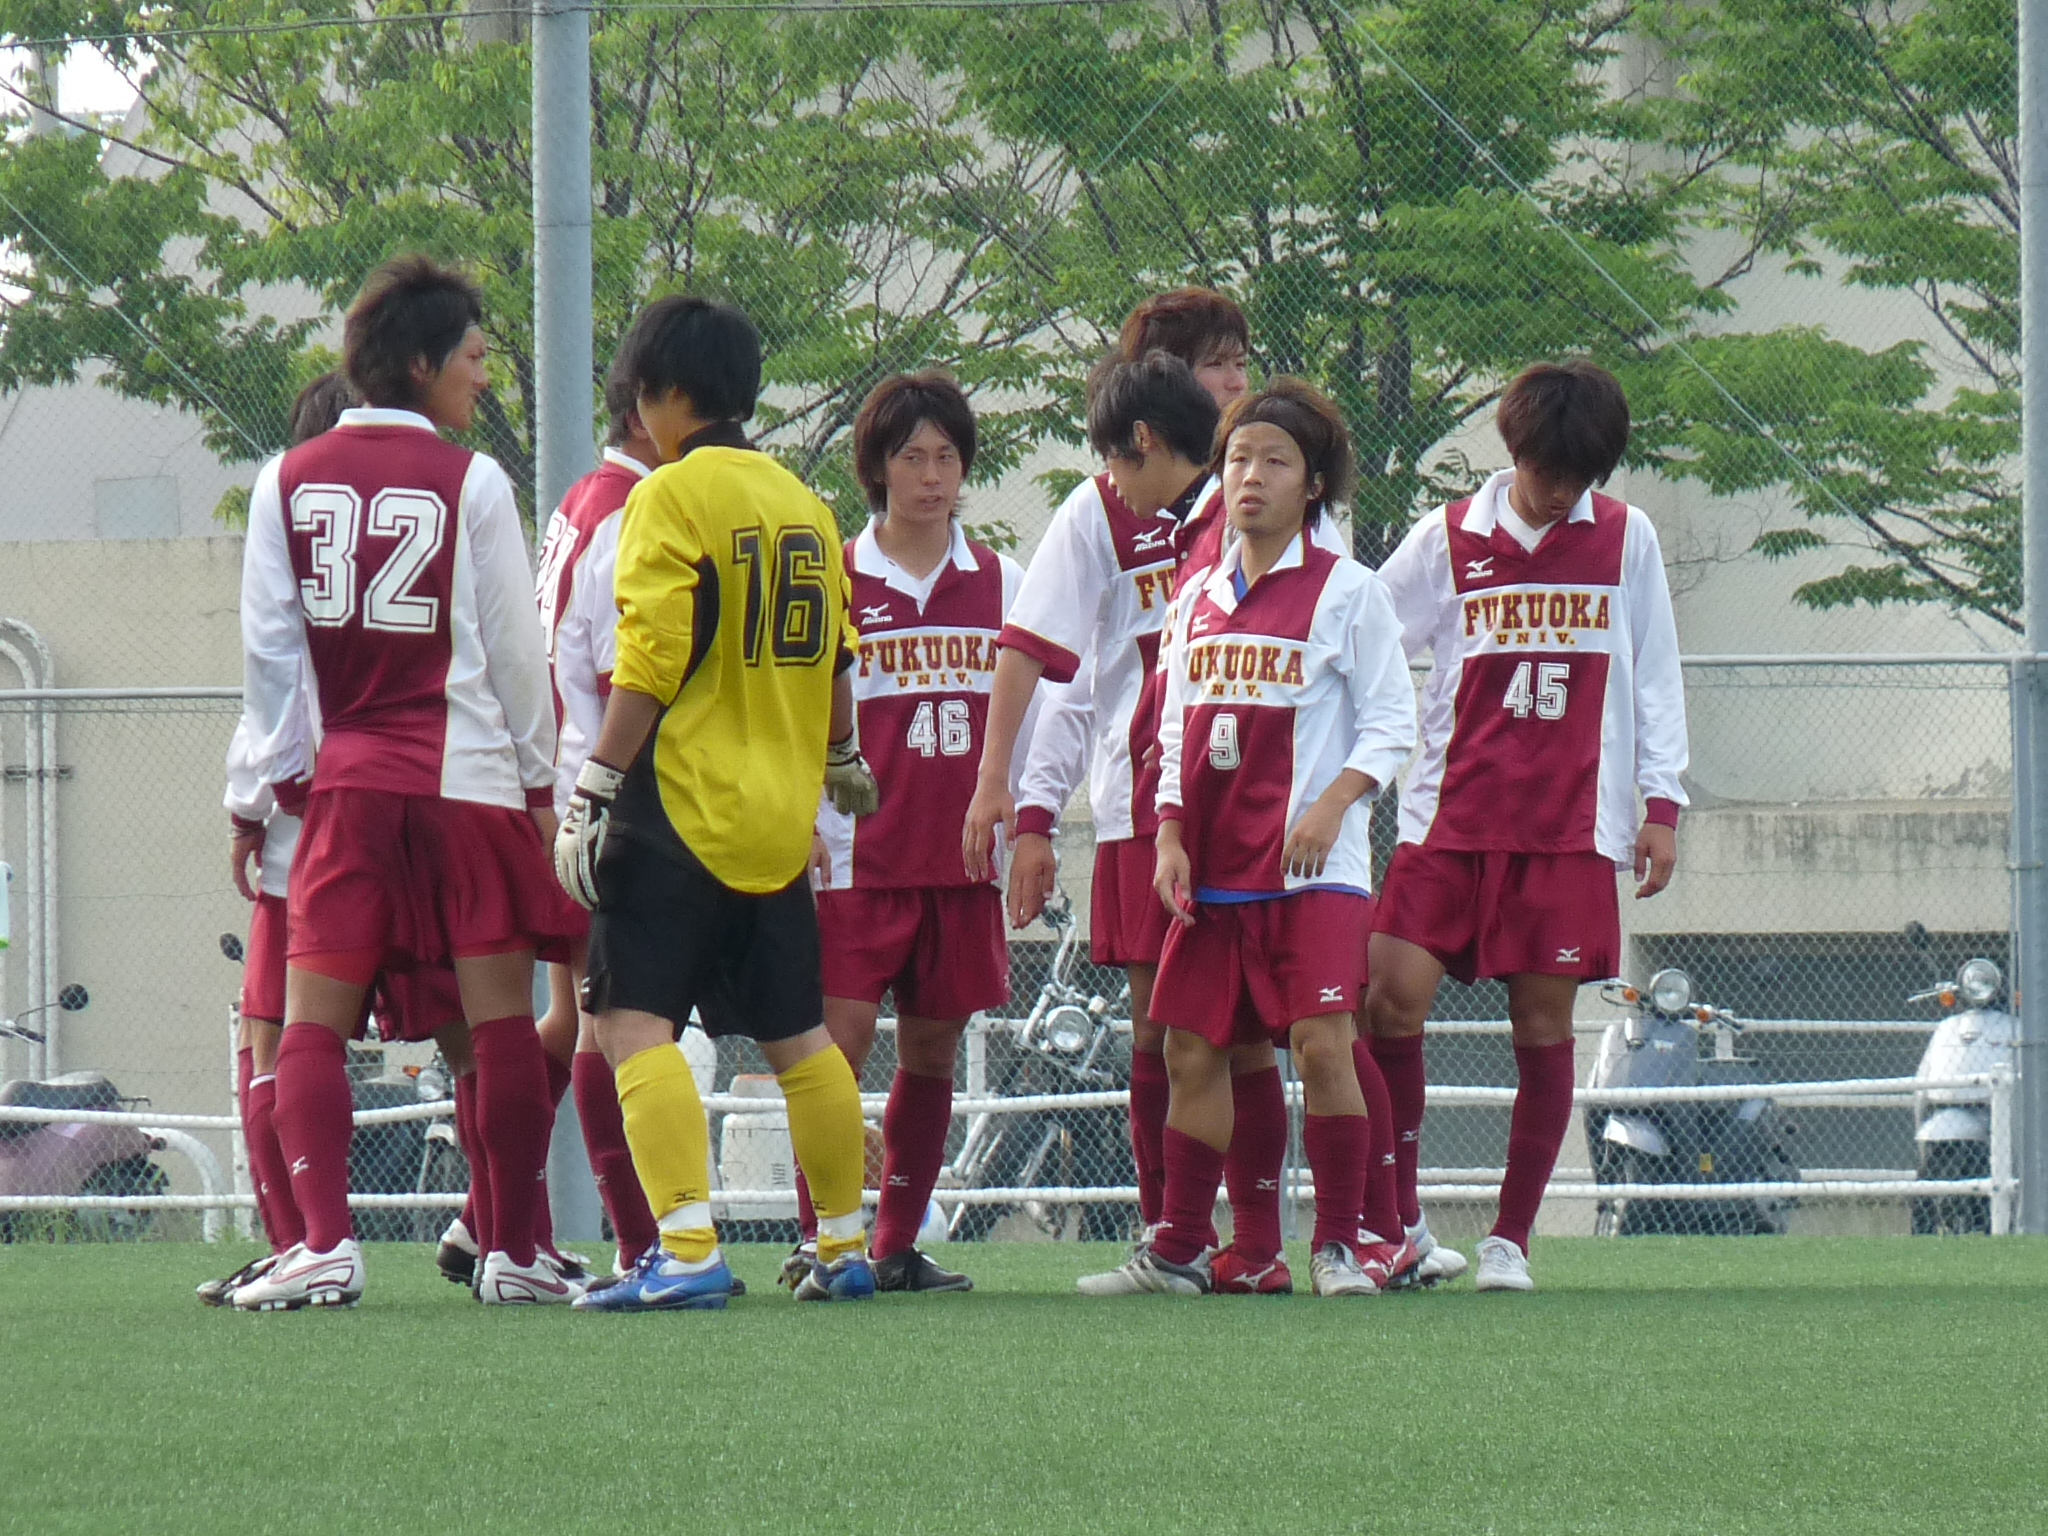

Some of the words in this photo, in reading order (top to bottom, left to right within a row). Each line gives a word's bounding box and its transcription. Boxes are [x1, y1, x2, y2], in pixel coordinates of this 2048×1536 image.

[290, 483, 447, 633] 32
[731, 524, 830, 668] 16
[1464, 593, 1610, 637] FUKUOKA
[858, 635, 997, 678] FUKUOKA
[1496, 631, 1576, 646] UNIV.
[897, 672, 973, 688] UNIV.
[1201, 684, 1263, 698] NIV.
[1502, 661, 1570, 720] 45
[907, 701, 971, 758] 46
[1209, 713, 1241, 770] 9
